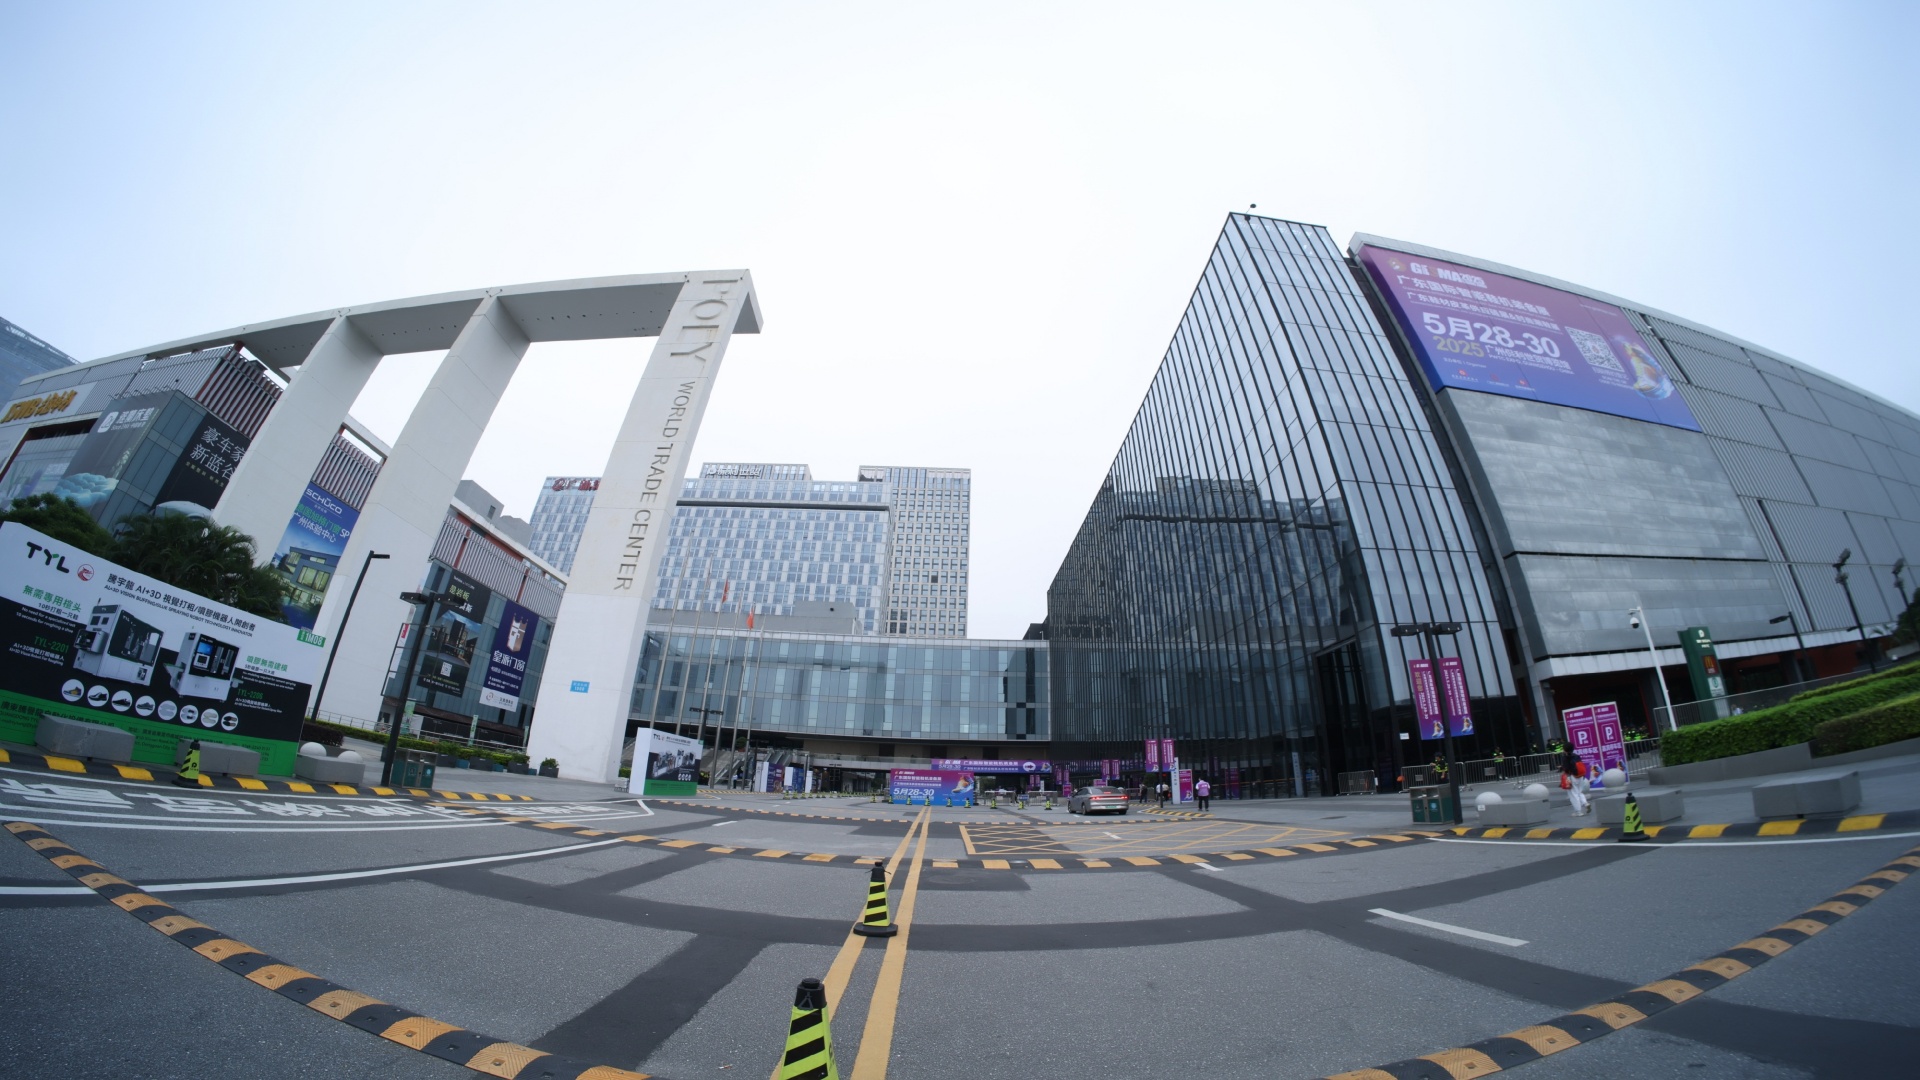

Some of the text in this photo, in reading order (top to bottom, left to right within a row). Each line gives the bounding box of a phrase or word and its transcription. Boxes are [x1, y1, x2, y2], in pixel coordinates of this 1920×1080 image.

[1422, 312, 1560, 358] 5月28-30
[1432, 335, 1485, 358] 2025
[662, 381, 696, 438] WORLD
[640, 443, 674, 503] TRADE
[27, 541, 70, 574] TYL
[614, 508, 652, 591] CENTER
[120, 589, 136, 600] VISION
[134, 585, 162, 600] AI+3D
[34, 635, 70, 654] TYL-2201
[893, 788, 935, 797] 5月28-30
